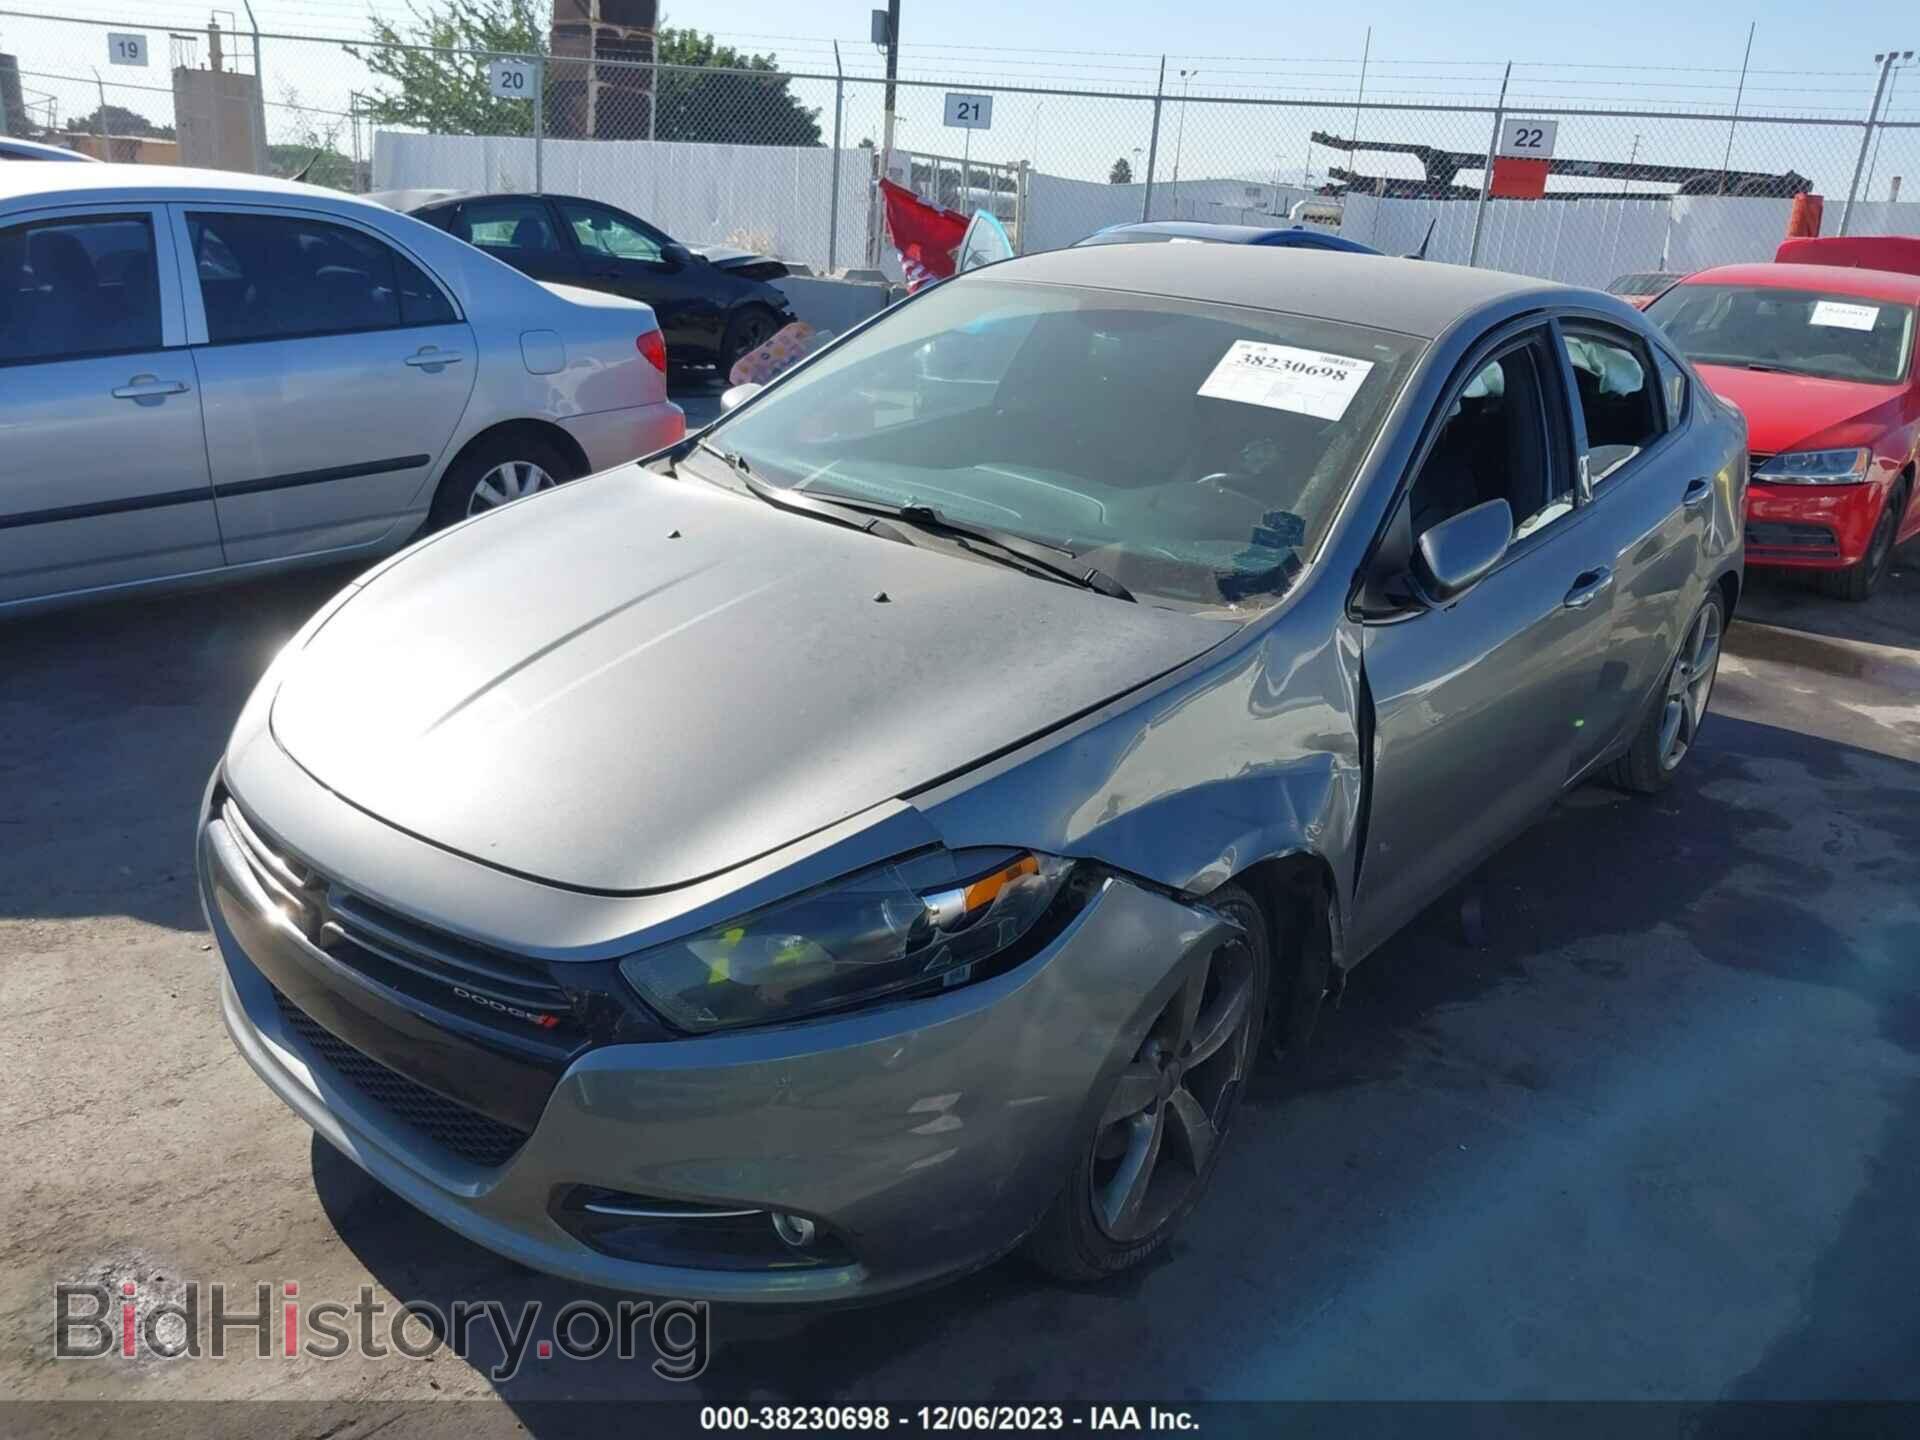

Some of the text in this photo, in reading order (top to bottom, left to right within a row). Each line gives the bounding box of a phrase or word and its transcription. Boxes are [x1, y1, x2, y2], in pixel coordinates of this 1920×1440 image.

[118, 40, 138, 58] 19
[501, 71, 524, 89] 20
[957, 102, 979, 120] 21
[1514, 128, 1543, 148] 22
[1235, 352, 1348, 382] 38230698
[453, 986, 542, 1024] DODGE
